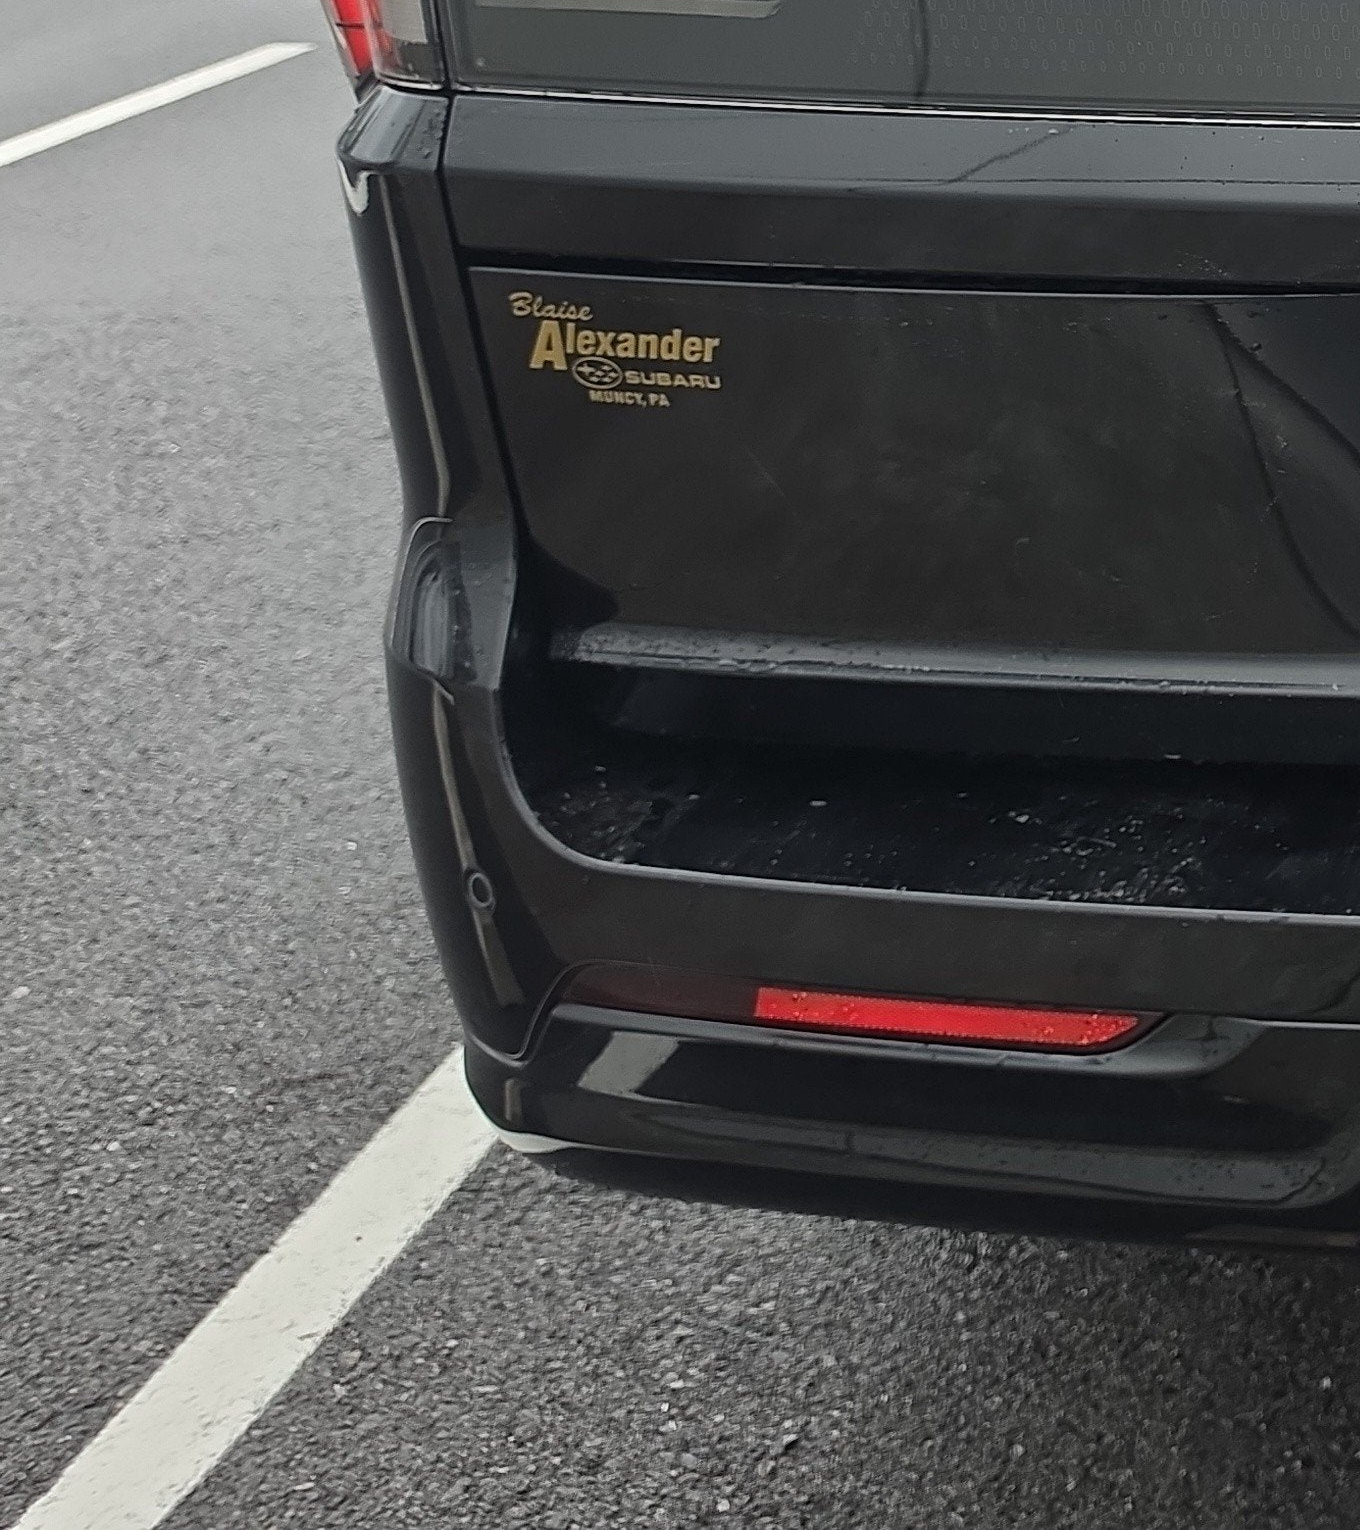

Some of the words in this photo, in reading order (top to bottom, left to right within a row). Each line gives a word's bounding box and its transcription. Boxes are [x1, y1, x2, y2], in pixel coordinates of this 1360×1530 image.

[508, 291, 593, 320] Blaise
[529, 320, 720, 370] Alexander
[624, 370, 721, 389] SUBARU
[649, 392, 670, 407] PA
